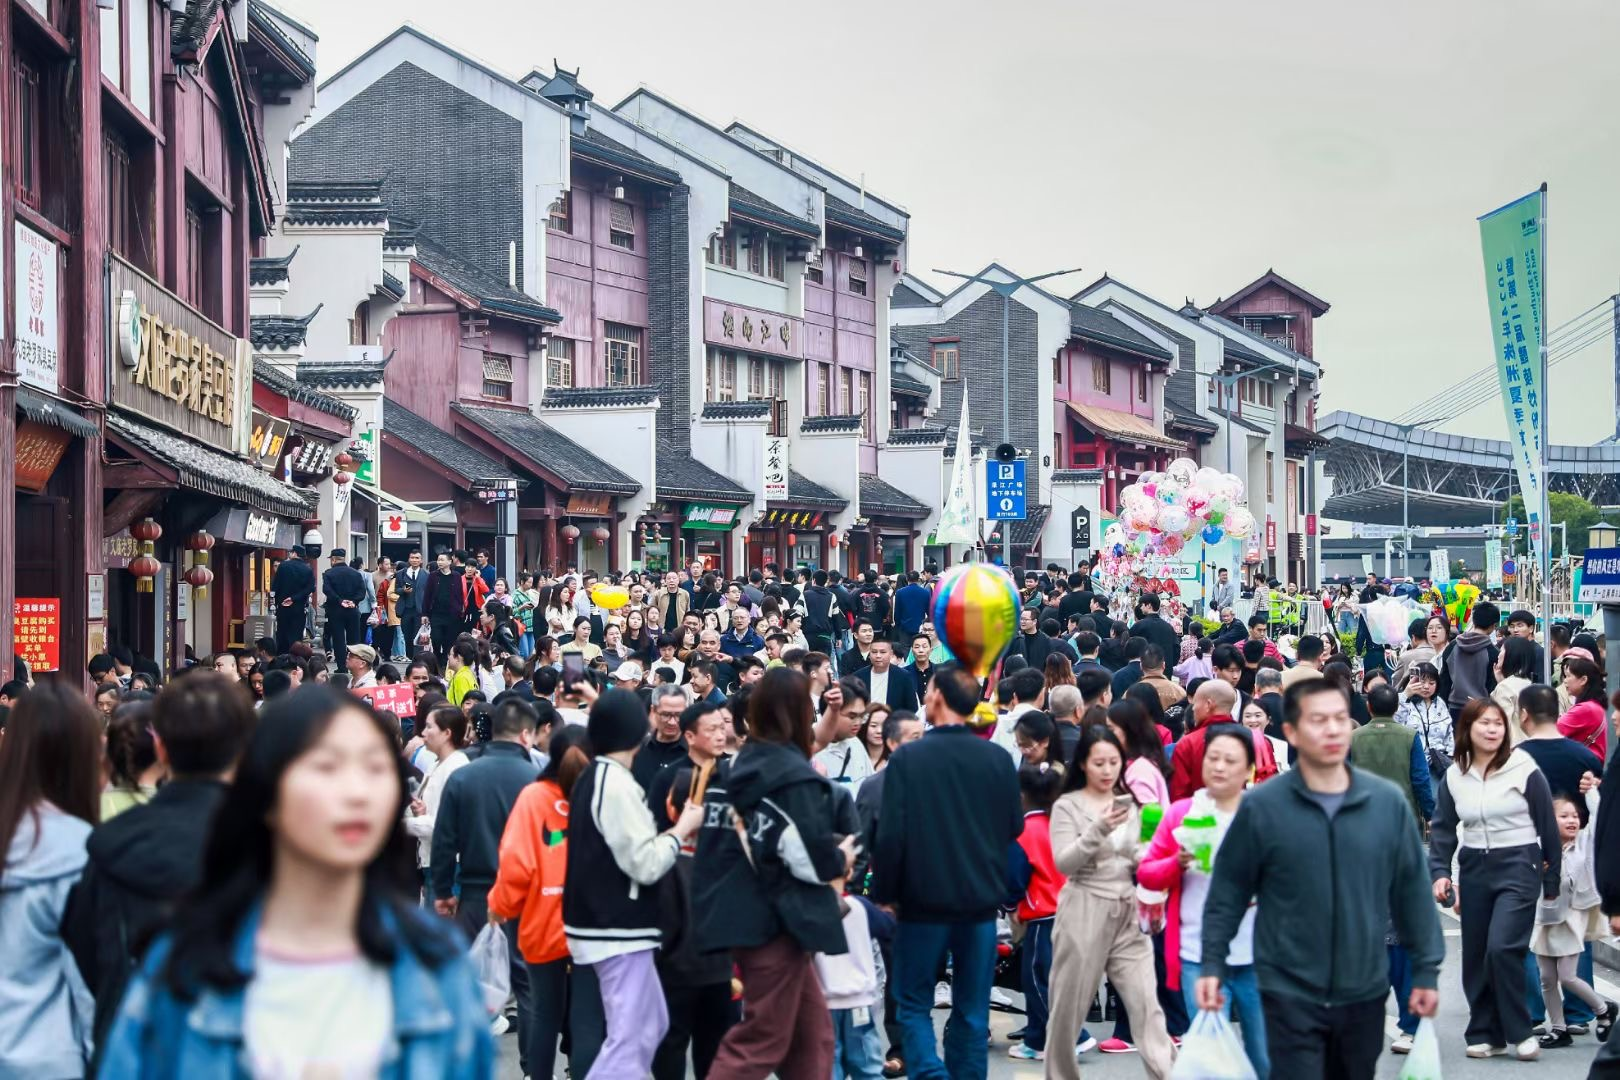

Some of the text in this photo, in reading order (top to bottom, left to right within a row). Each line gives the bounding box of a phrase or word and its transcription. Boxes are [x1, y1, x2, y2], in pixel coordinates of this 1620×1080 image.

[766, 440, 783, 483] 茶餐吧
[1002, 466, 1011, 478] P
[1077, 517, 1088, 530] P
[23, 604, 55, 612] 温馨提示
